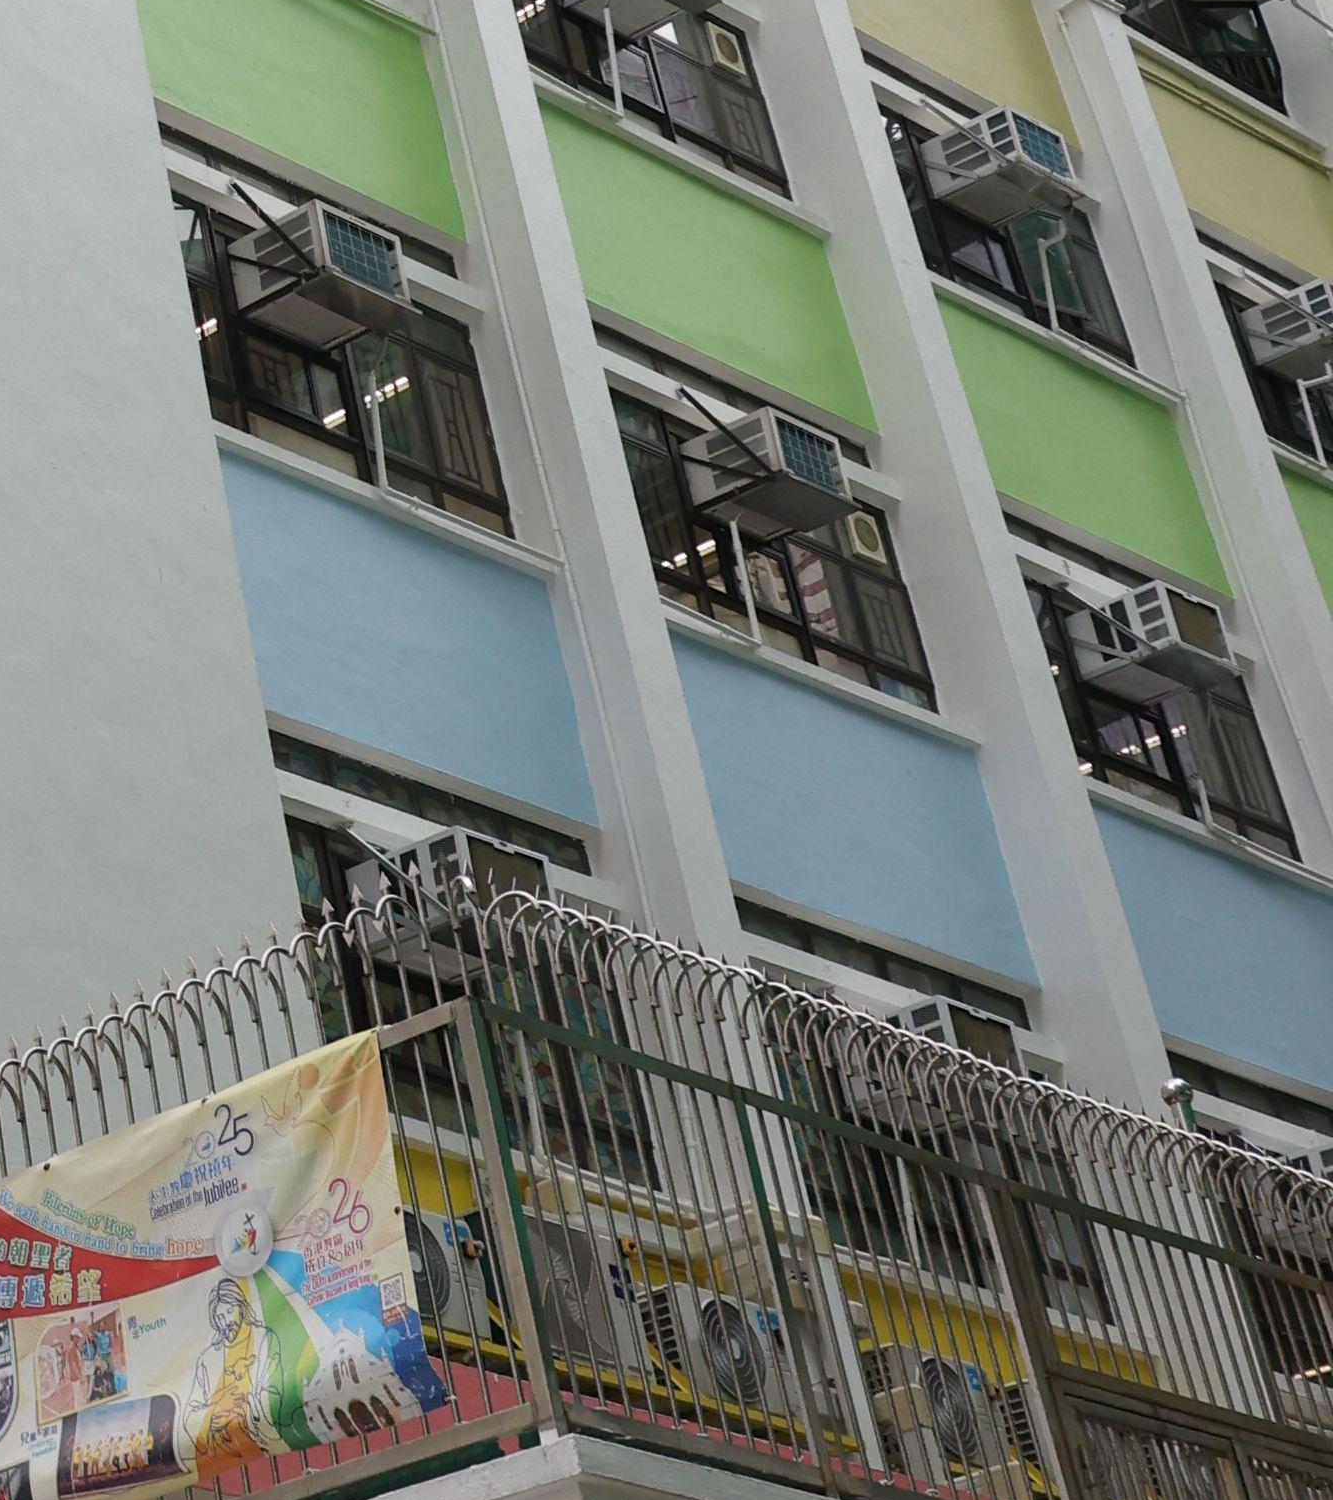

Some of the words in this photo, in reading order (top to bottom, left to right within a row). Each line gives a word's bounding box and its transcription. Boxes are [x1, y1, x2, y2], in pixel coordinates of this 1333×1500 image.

[202, 1177, 240, 1208] Jubilee
[39, 1214, 70, 1239] hand
[83, 1232, 112, 1251] hand
[132, 1239, 164, 1257] bring
[166, 1236, 204, 1256] hope
[138, 1316, 167, 1335] Youth
